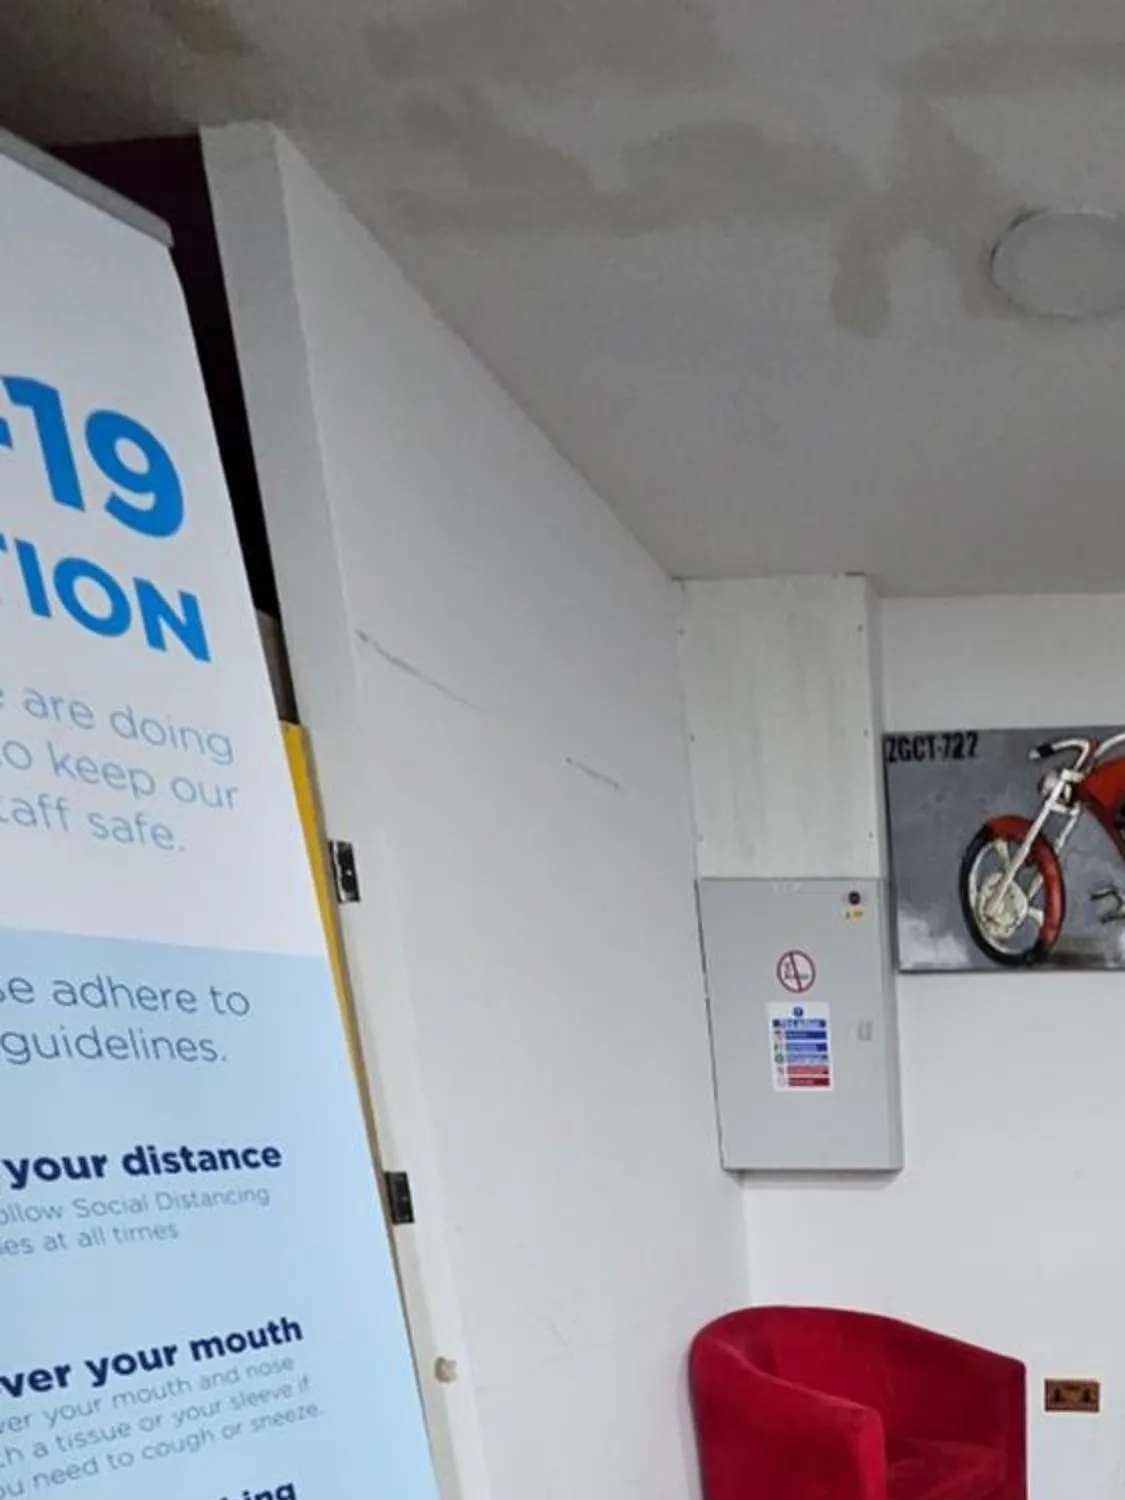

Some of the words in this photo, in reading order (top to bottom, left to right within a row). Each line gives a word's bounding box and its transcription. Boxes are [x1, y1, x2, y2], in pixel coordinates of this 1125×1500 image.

[0, 535, 211, 662] ION
[23, 686, 96, 730] are
[108, 704, 235, 766] doing
[46, 740, 156, 799] keep
[170, 776, 239, 810] our
[87, 811, 185, 852] safe.
[52, 974, 198, 1014] adhere
[209, 985, 251, 1017] to
[0, 1024, 227, 1066] guidelines.
[2, 1152, 109, 1191] your
[122, 1145, 282, 1177] distance
[43, 1231, 66, 1252] at
[78, 1226, 106, 1249] all
[113, 1221, 178, 1245] times
[72, 1194, 149, 1220] Social
[154, 1187, 270, 1212] Distancing
[84, 1344, 178, 1388] your
[189, 1316, 304, 1362] mouth
[32, 1440, 50, 1460] a
[56, 1421, 132, 1453] tissue
[139, 1413, 163, 1434] or
[171, 1400, 222, 1428] your
[230, 1382, 294, 1411] sleeve
[43, 1398, 103, 1429] your
[112, 1377, 192, 1409] mouth
[199, 1369, 241, 1391] and
[246, 1356, 295, 1381] nose
[32, 1459, 100, 1491] need
[106, 1451, 135, 1471] to
[142, 1428, 216, 1463] cough
[222, 1421, 244, 1441] or
